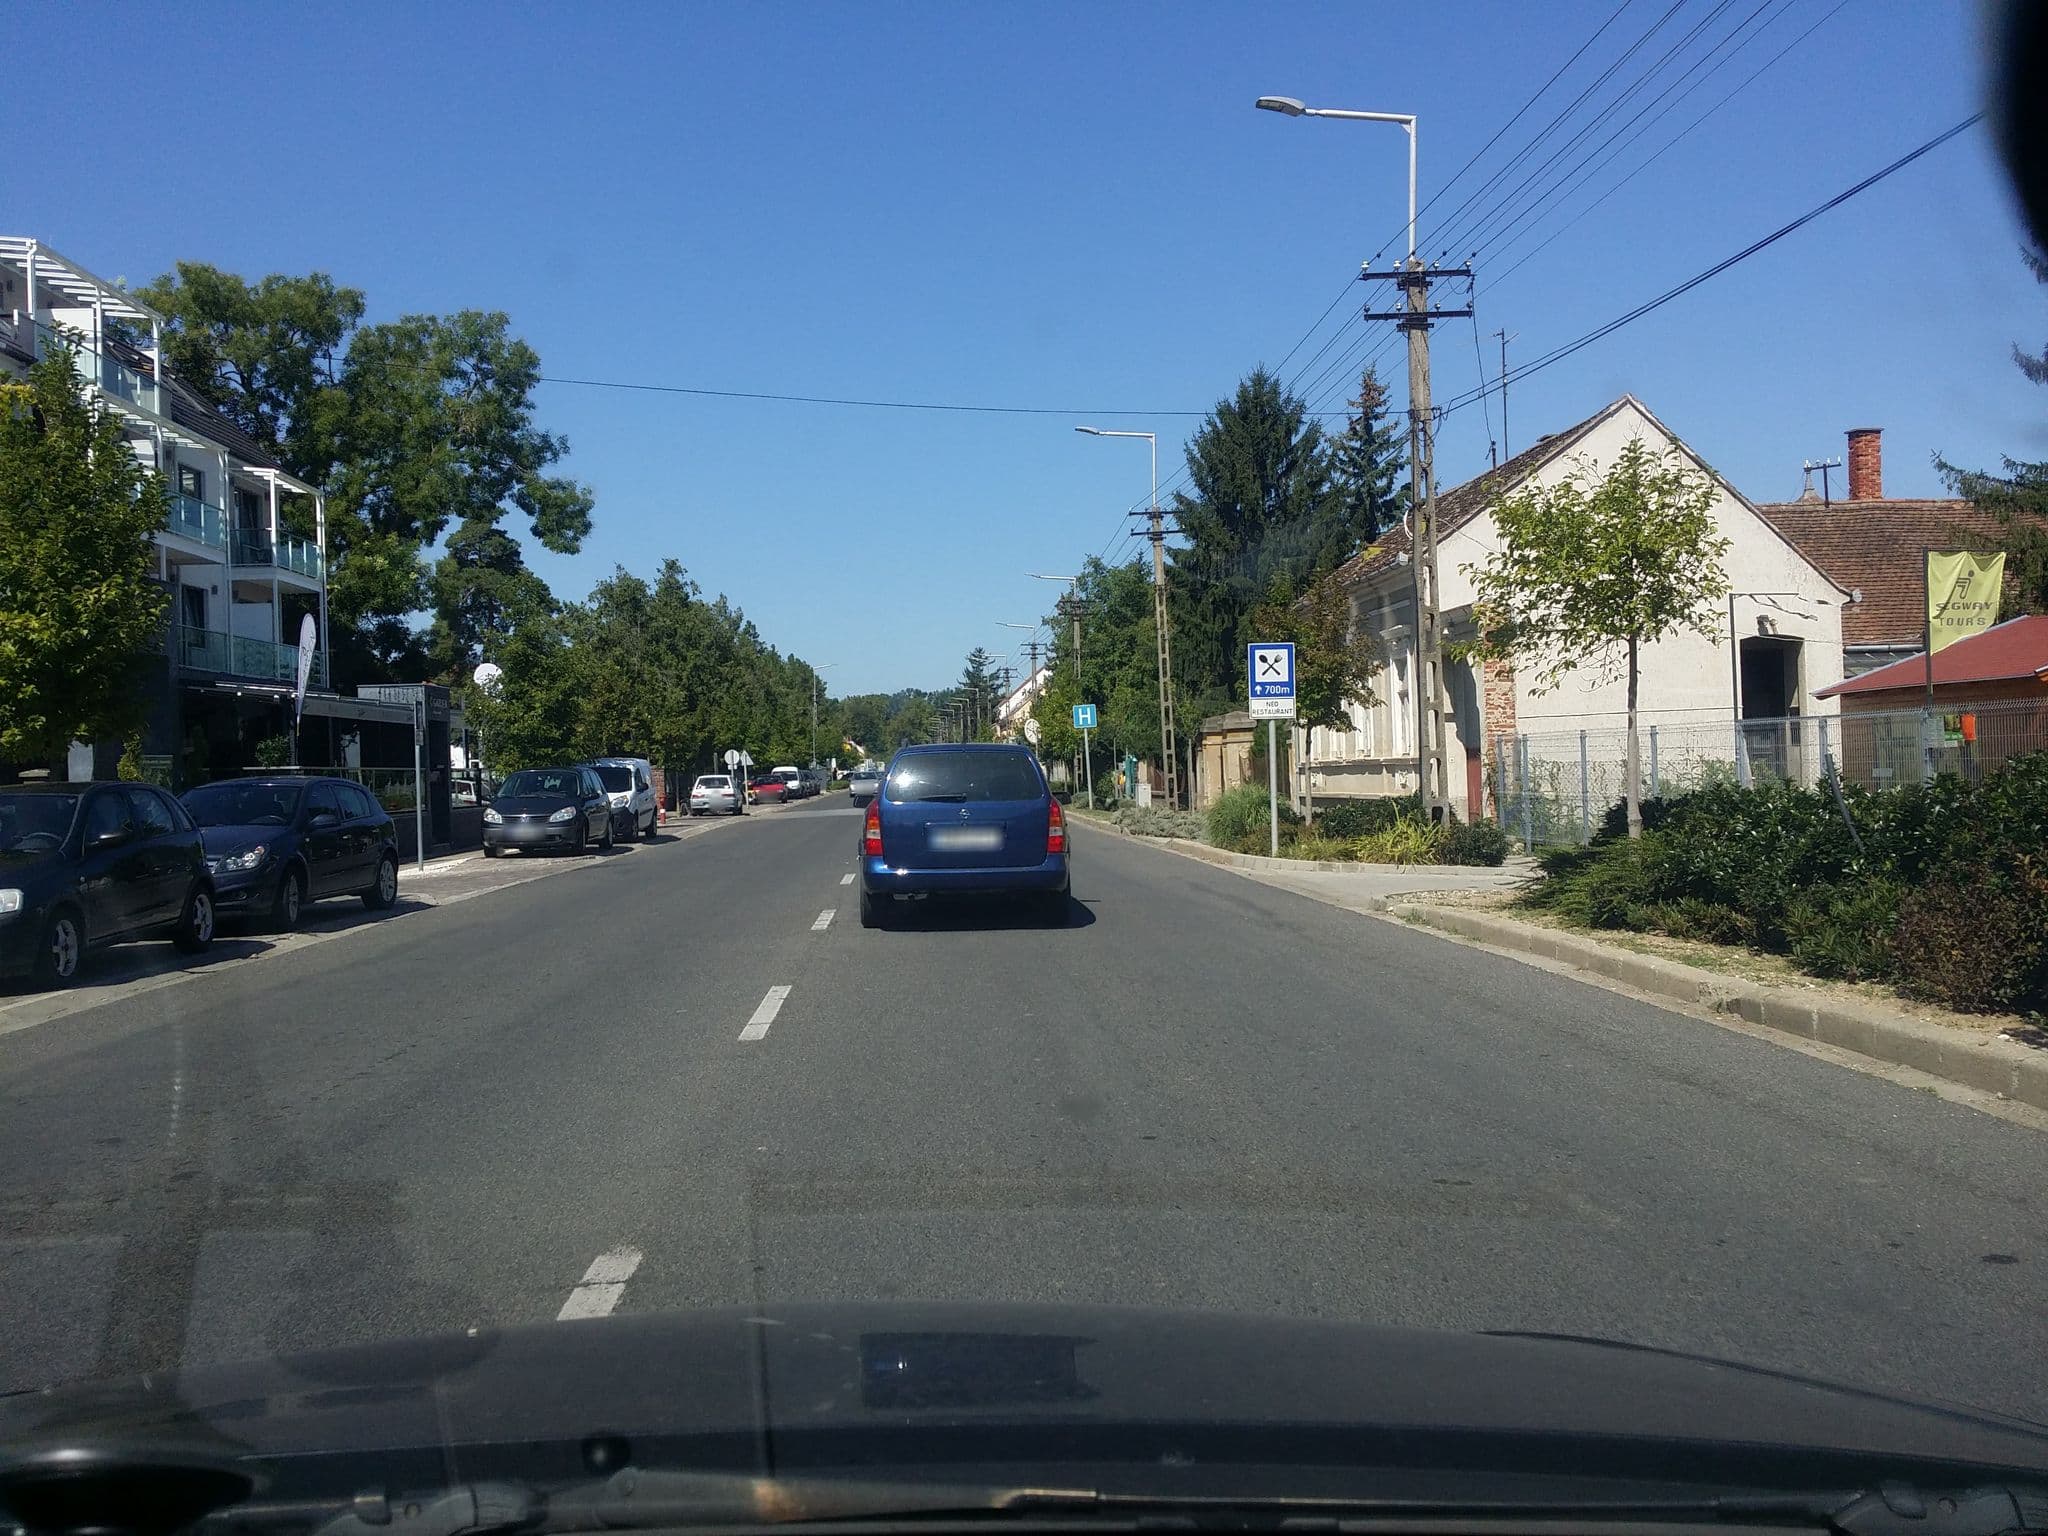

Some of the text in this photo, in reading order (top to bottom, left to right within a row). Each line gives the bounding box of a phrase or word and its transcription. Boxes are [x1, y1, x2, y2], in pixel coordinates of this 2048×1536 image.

[1940, 617, 1986, 626] TOURS
[1264, 685, 1290, 695] 700m
[1079, 707, 1091, 725] H
